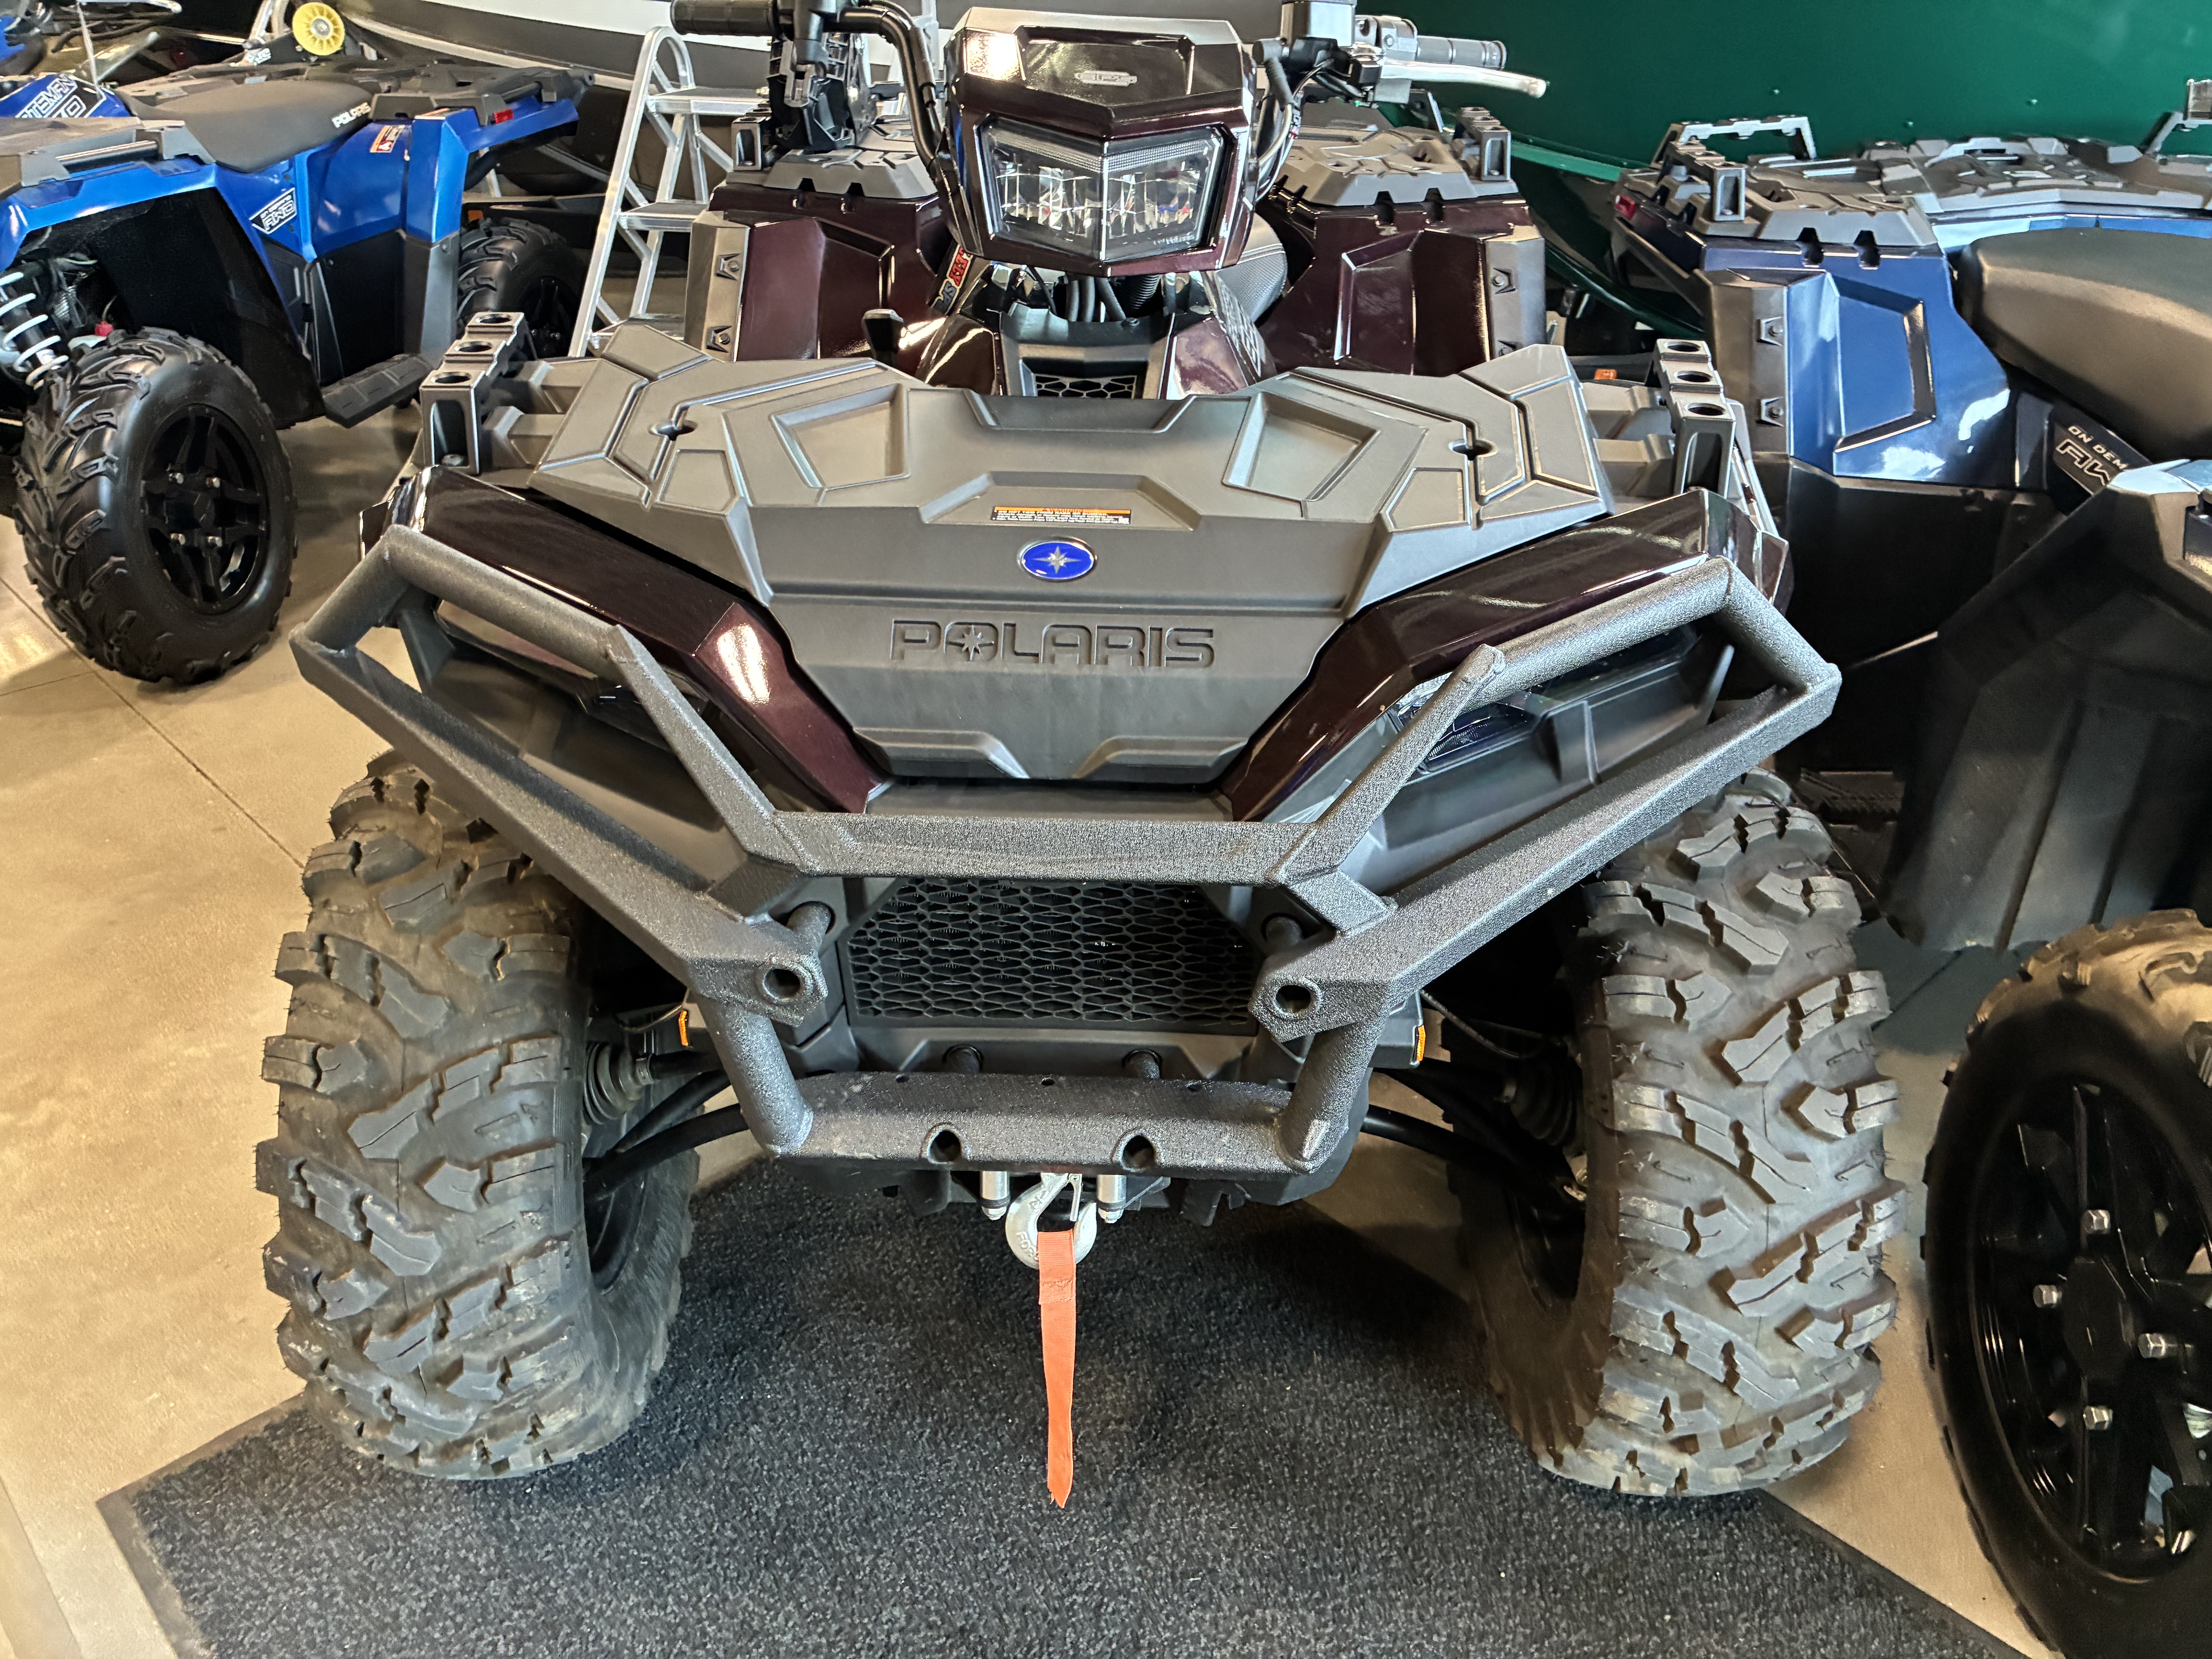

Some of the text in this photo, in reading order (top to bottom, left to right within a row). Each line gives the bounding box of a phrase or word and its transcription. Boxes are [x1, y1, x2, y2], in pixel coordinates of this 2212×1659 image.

[2068, 426, 2128, 469] ON DEM
[890, 619, 1215, 668] POLARIS
